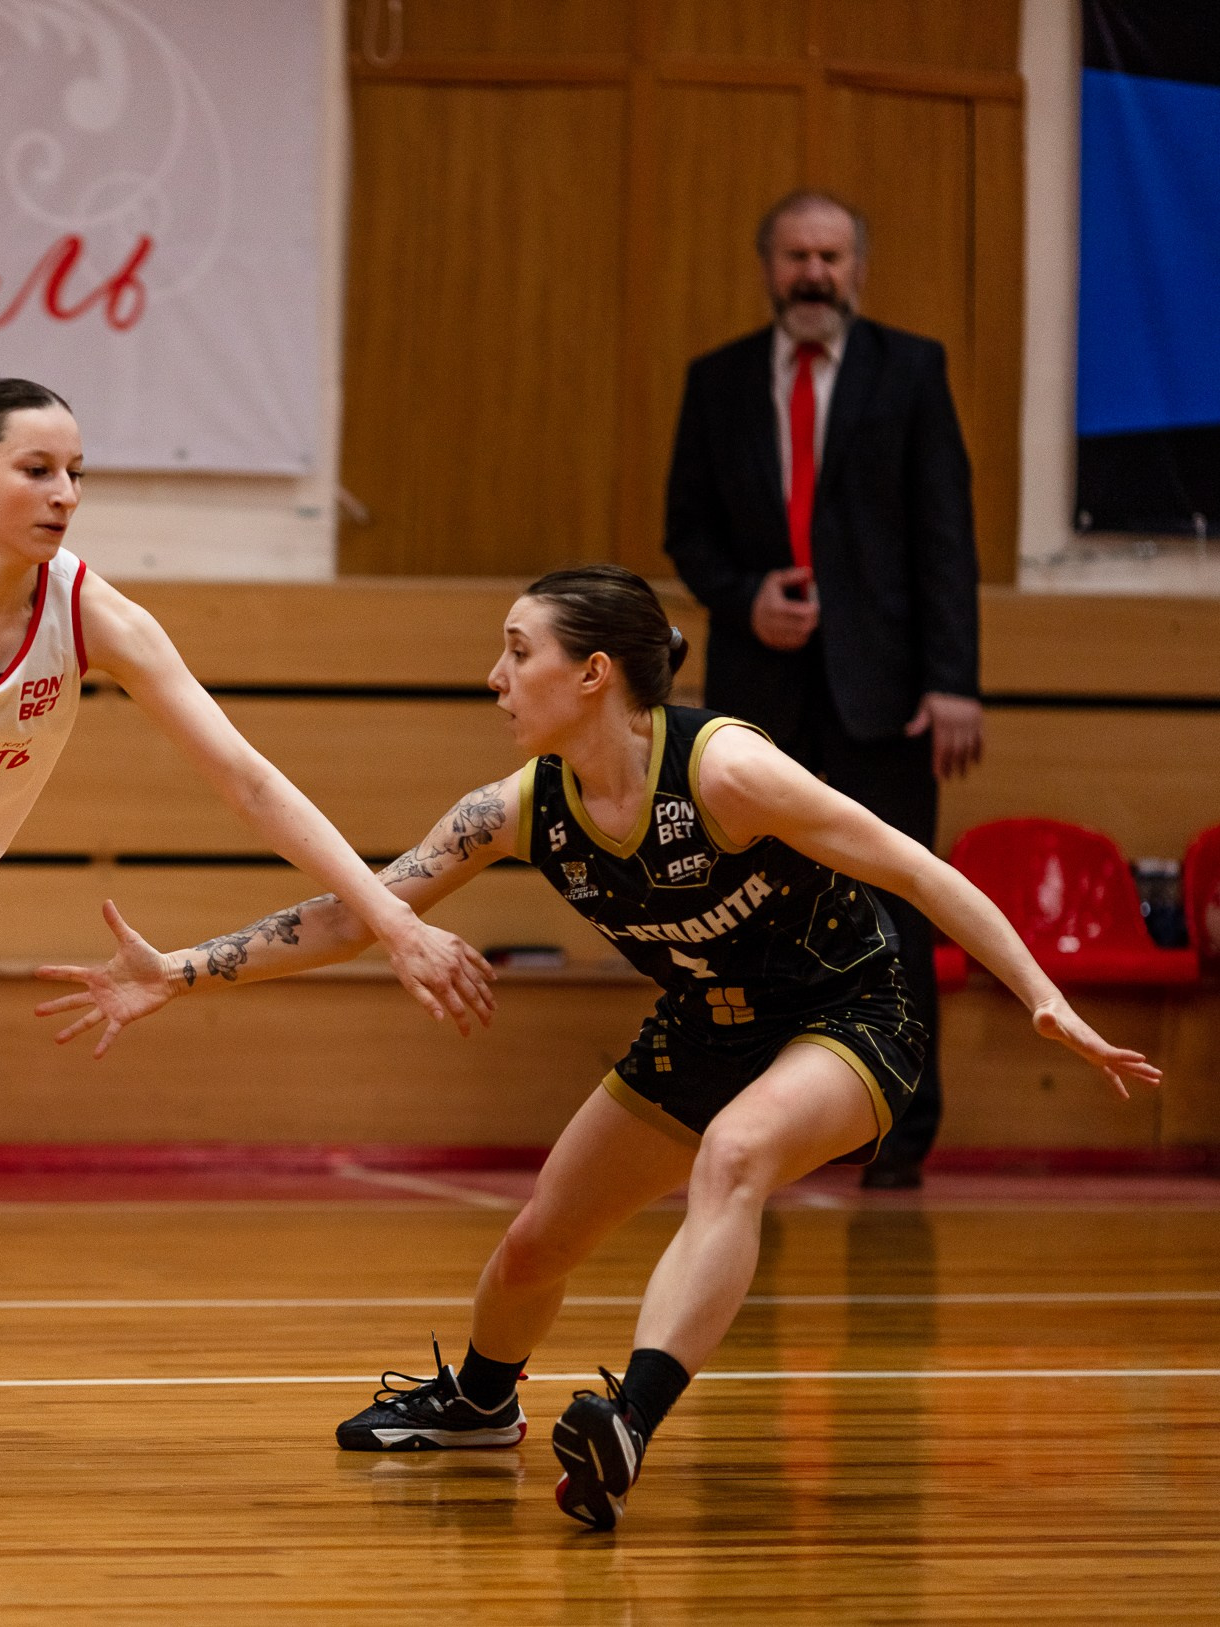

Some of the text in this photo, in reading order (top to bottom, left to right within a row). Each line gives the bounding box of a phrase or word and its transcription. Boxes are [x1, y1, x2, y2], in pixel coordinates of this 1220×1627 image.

[20, 673, 64, 701] FON
[19, 692, 60, 721] BET
[655, 801, 695, 824] FON
[658, 821, 694, 845] BET
